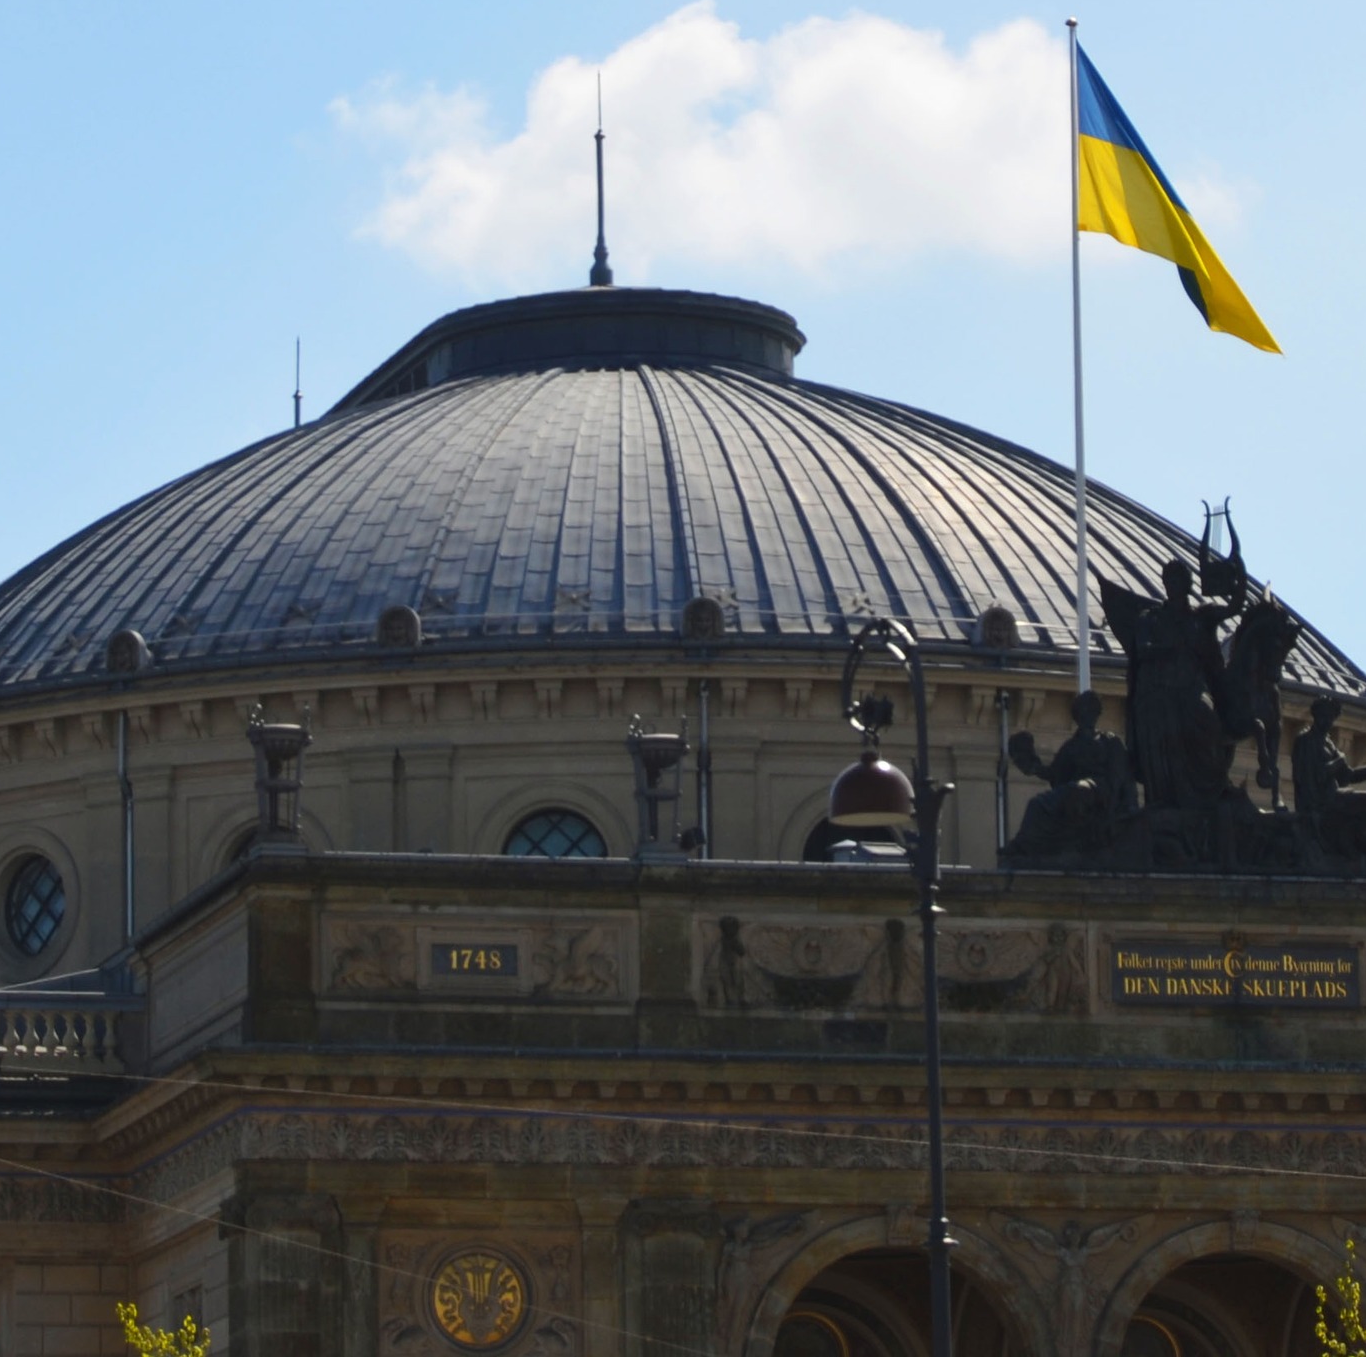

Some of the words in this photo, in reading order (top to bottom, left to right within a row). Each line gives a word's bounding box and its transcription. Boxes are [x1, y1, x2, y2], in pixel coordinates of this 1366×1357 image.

[451, 949, 501, 970] 1748
[1117, 951, 1153, 969] Folket
[1190, 954, 1222, 970] under
[1245, 955, 1280, 971] denne
[1283, 954, 1335, 977] Bygning
[1337, 957, 1352, 974] for
[1124, 977, 1160, 995] DEN
[1166, 978, 1234, 996] DANSKE
[1242, 978, 1347, 998] SKUEPLADS
